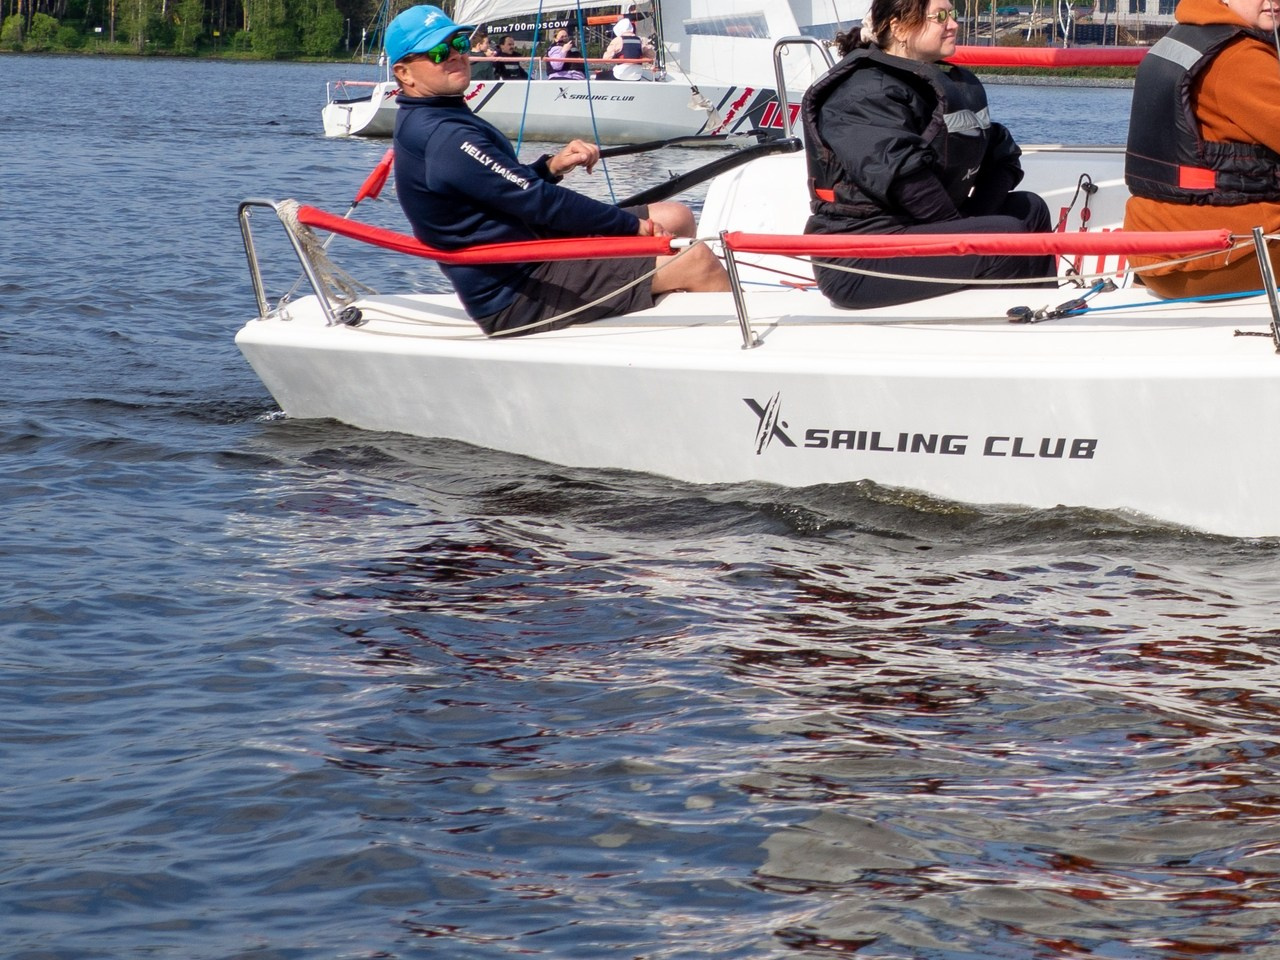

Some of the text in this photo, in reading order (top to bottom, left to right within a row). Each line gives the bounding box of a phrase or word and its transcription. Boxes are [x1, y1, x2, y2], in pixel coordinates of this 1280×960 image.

[460, 141, 530, 190] HELLY HANSEN
[804, 428, 969, 456] SAILING
[983, 436, 1099, 460] CLUB
